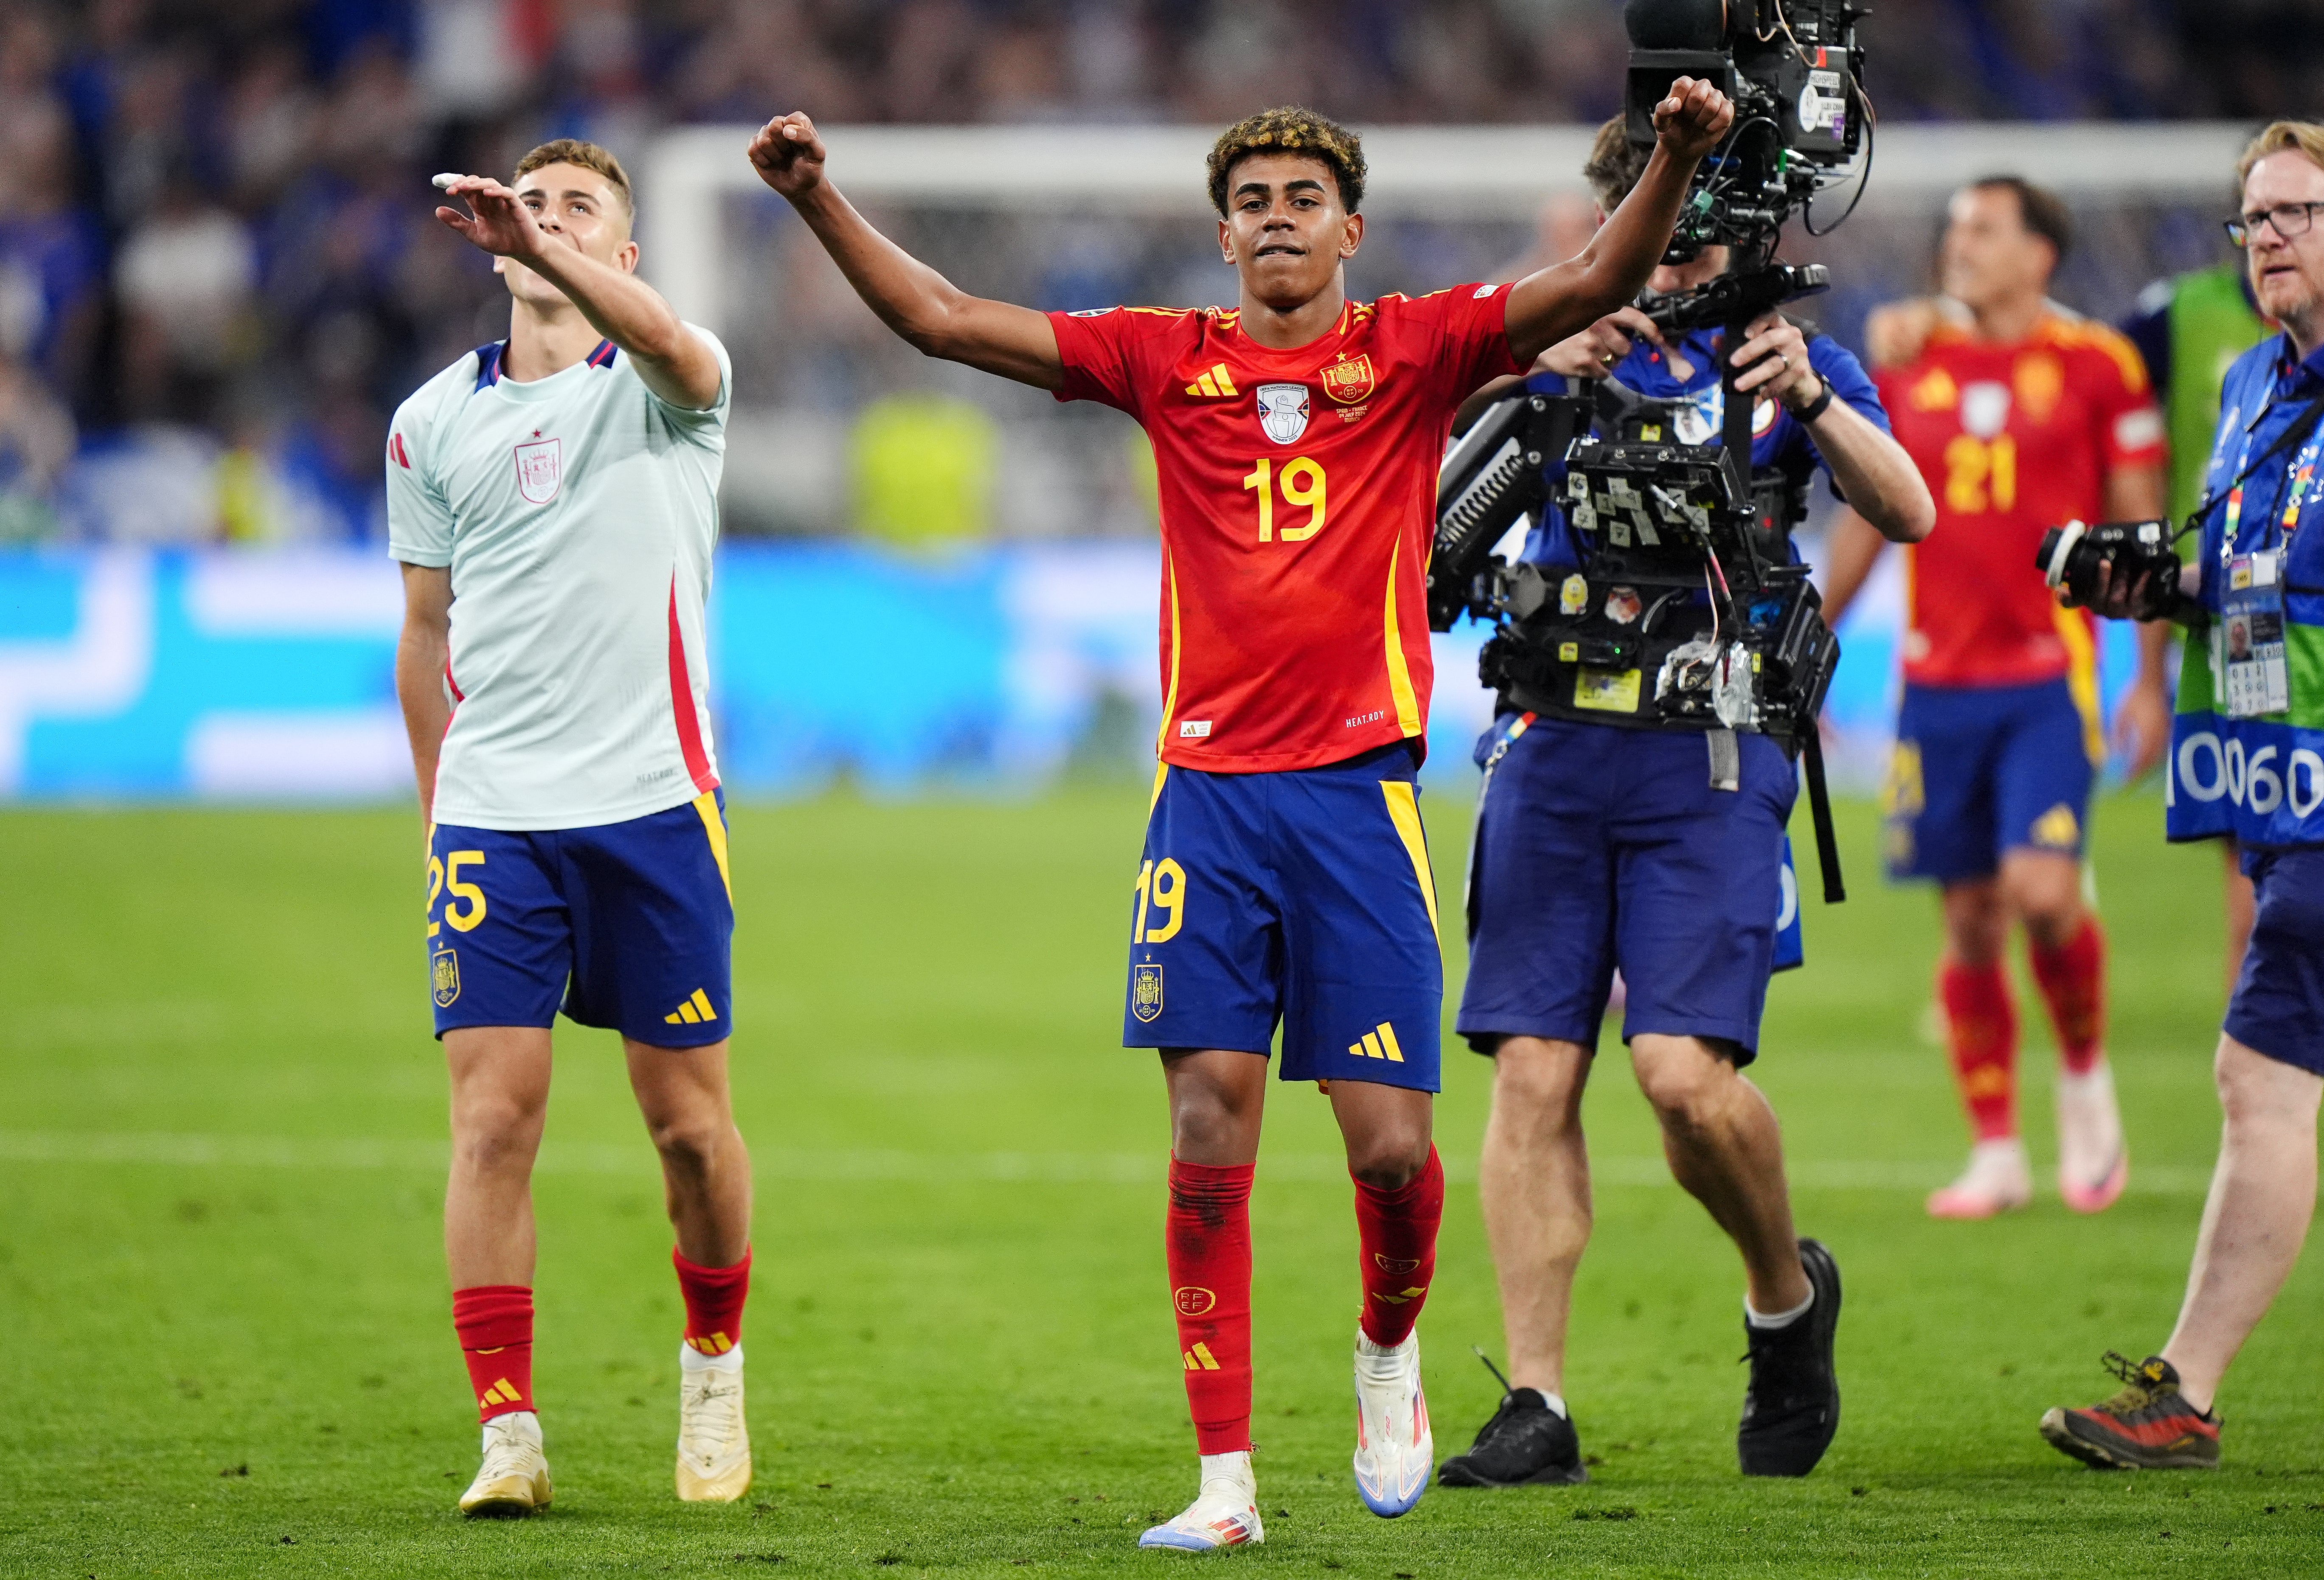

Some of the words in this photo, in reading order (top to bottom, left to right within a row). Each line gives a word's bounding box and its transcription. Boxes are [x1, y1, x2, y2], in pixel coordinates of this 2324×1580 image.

[1244, 456, 1326, 542] 19
[1944, 433, 2018, 514] 21
[1346, 710, 1384, 728] HEAT.RDY
[427, 850, 487, 938] 25
[1134, 857, 1186, 944] 19
